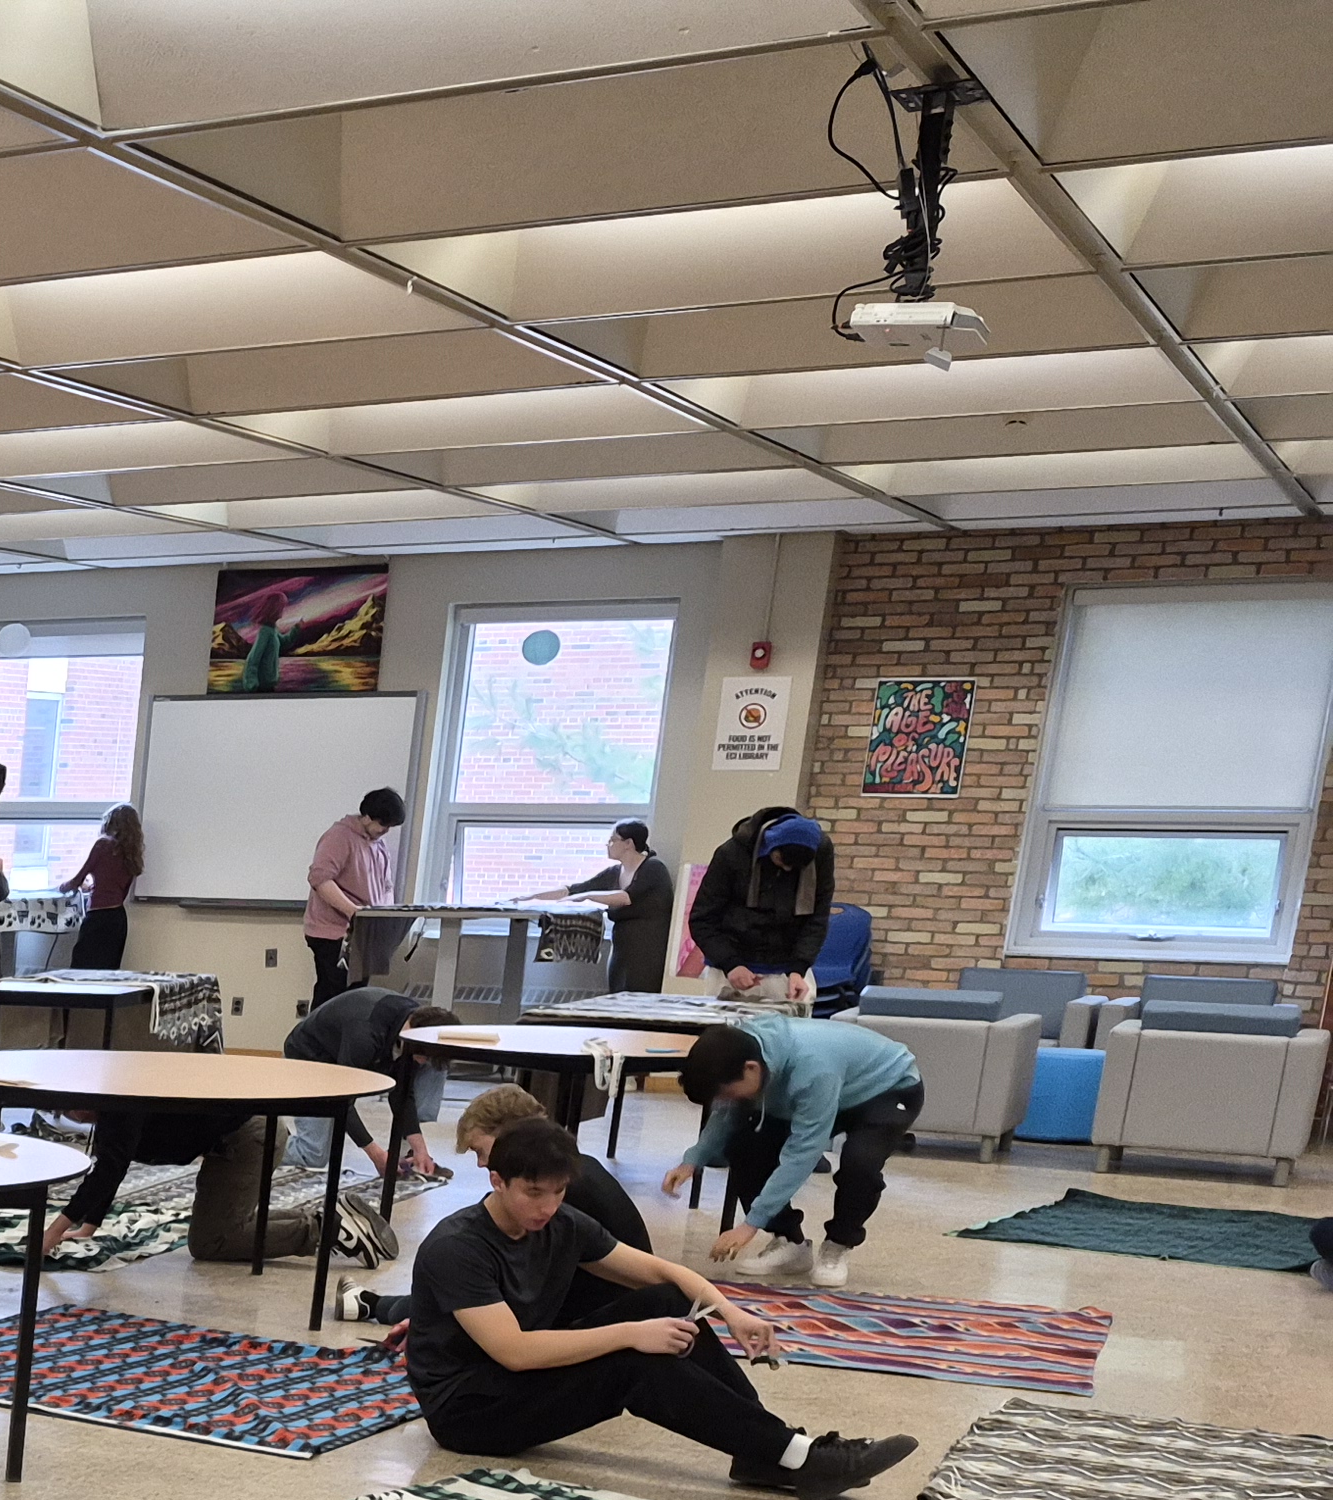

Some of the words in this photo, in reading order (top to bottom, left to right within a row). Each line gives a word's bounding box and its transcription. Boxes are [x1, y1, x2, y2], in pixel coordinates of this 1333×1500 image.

[735, 688, 778, 700] ATTENTION
[902, 689, 933, 712] THE
[885, 706, 935, 733] AGE
[728, 735, 747, 743] FOOD
[748, 735, 756, 743] IS
[757, 735, 771, 743] NOT
[717, 743, 756, 752] PERMITTED
[757, 743, 765, 752] IN
[766, 743, 780, 752] THE
[725, 752, 737, 760] ECI
[738, 752, 769, 760] LIBRARY
[870, 742, 960, 792] PLEASURE
